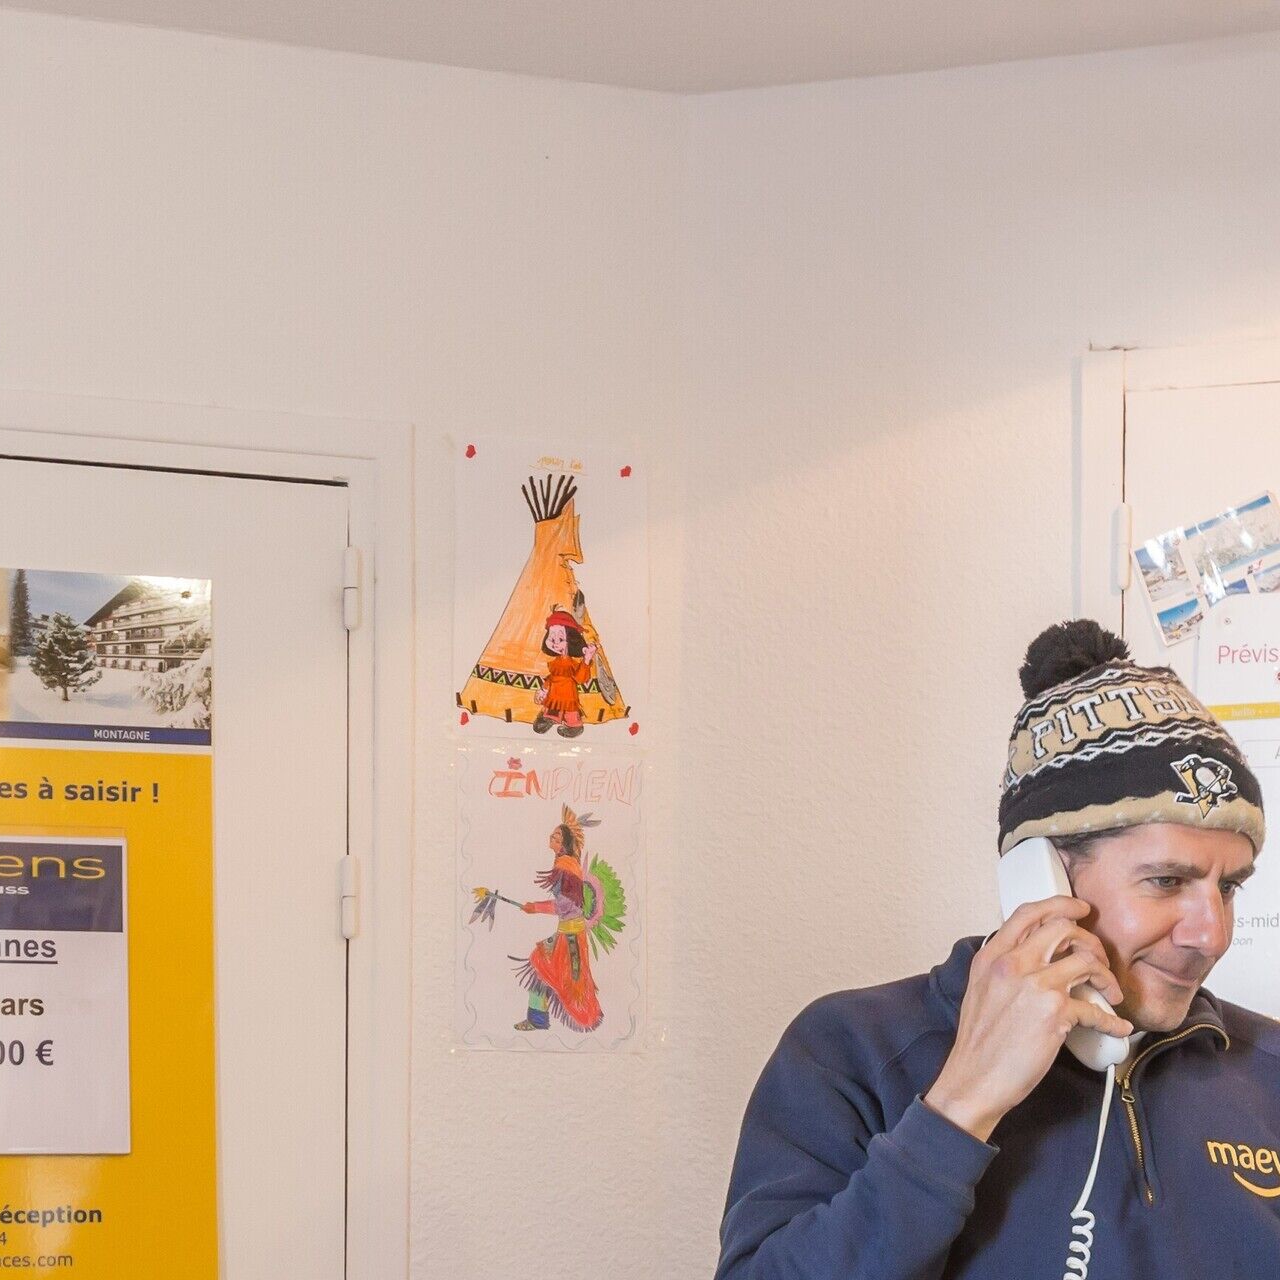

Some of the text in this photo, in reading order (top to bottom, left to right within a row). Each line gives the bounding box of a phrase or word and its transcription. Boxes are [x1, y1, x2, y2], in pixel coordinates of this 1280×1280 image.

[94, 729, 151, 741] MONTAGNE
[38, 776, 54, 800] à
[64, 780, 142, 802] saisir
[152, 782, 159, 803] !
[35, 1039, 55, 1066] €
